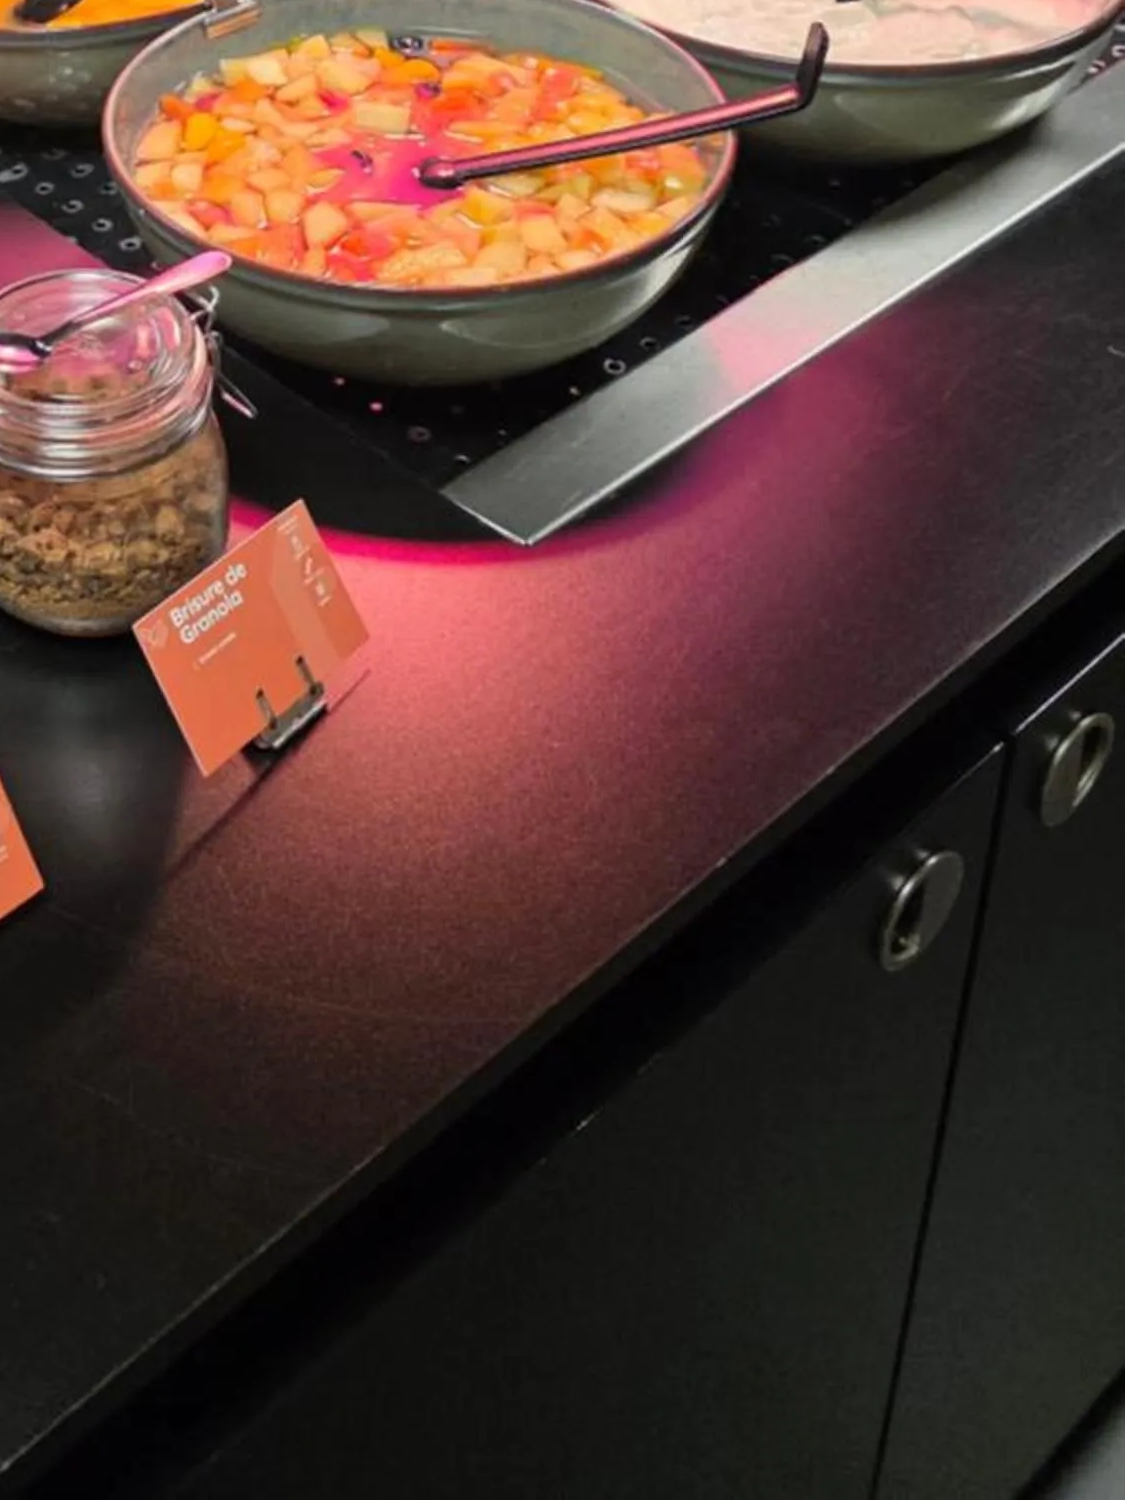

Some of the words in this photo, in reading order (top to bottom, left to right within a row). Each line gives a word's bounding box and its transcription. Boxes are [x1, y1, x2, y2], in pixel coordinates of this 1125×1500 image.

[169, 578, 225, 628] Brisure
[225, 562, 247, 585] de
[179, 589, 243, 644] Granola
